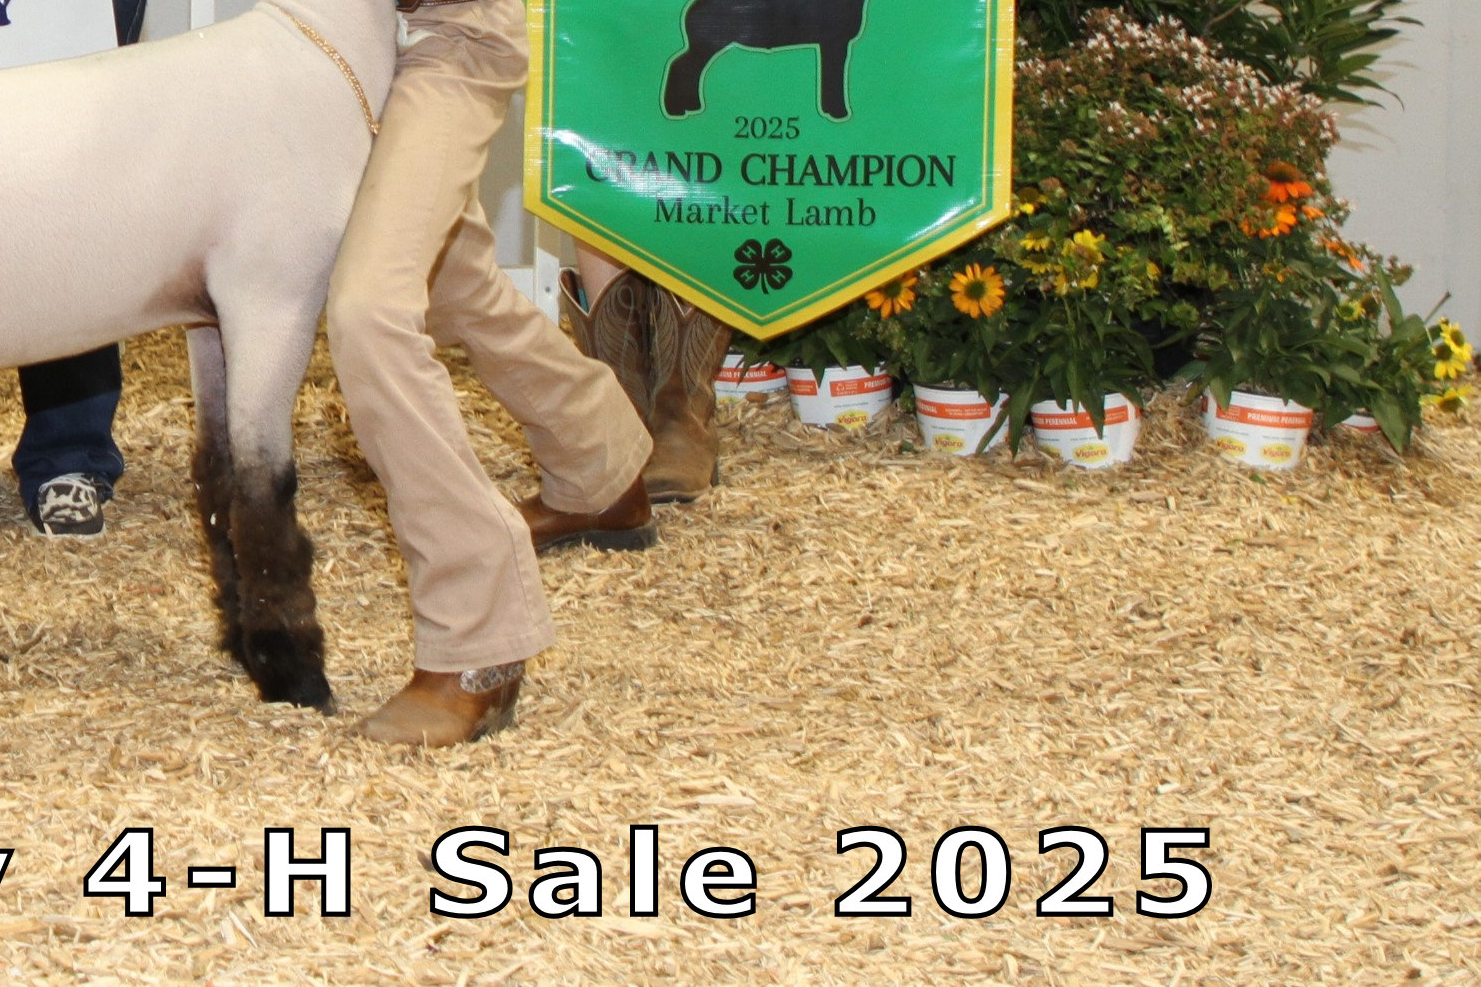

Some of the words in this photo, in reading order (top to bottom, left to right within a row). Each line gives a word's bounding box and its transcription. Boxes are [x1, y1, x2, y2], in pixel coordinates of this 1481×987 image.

[733, 116, 801, 140] 2025
[585, 151, 722, 184] GRAND
[740, 153, 957, 188] CHAMPION
[654, 197, 770, 225] Market
[785, 197, 877, 227] Lamb
